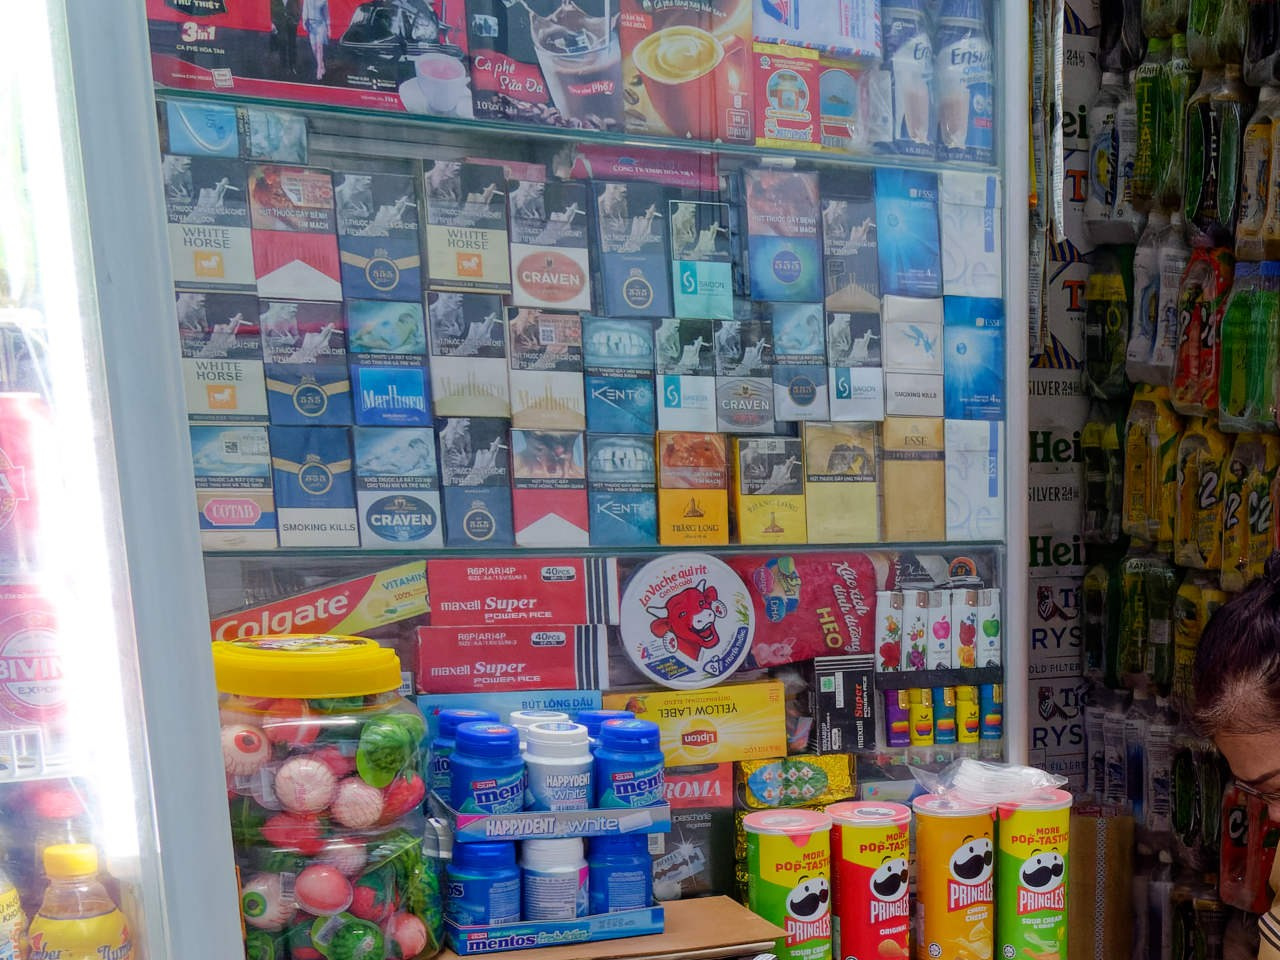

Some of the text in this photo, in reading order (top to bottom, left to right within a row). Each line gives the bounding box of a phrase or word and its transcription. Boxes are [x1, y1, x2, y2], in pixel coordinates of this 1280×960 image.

[182, 227, 230, 238] WHITE
[447, 229, 488, 240] WHITE
[183, 238, 231, 249] HORSE
[448, 239, 489, 250] HORSE
[522, 271, 580, 287] CRAVEN
[196, 361, 242, 371] WHITE
[196, 370, 243, 381] HORSE
[363, 385, 425, 412] Marlboro
[592, 387, 636, 401] KENT
[722, 399, 769, 411] CRAVEN
[904, 436, 927, 447] ESSE
[597, 501, 641, 515] KENT
[371, 514, 432, 526] CRAVEN
[283, 523, 356, 532] SMOKING KILLS
[382, 571, 426, 592] VITAMIN
[640, 565, 708, 606] La Vache qui rit
[441, 597, 537, 614] maxell Super
[215, 592, 349, 640] Colgate
[485, 612, 523, 621] POWER
[816, 607, 843, 649] HEO
[431, 661, 526, 678] maxell Super
[710, 665, 717, 673] 8
[474, 676, 513, 685] POWER
[854, 683, 863, 718] Super
[657, 702, 738, 719] YELLOW LABEL
[685, 732, 714, 742] Lipton
[547, 775, 590, 787] HAPPYDENT
[553, 789, 586, 798] white
[486, 816, 617, 836] HAPPYDENT white
[1036, 826, 1060, 835] MORE
[886, 832, 906, 842] MORE
[1012, 832, 1070, 845] POP-TASTIC
[802, 850, 824, 862] MORE
[1020, 886, 1064, 911] PRINGLES
[467, 934, 536, 951] mentos
